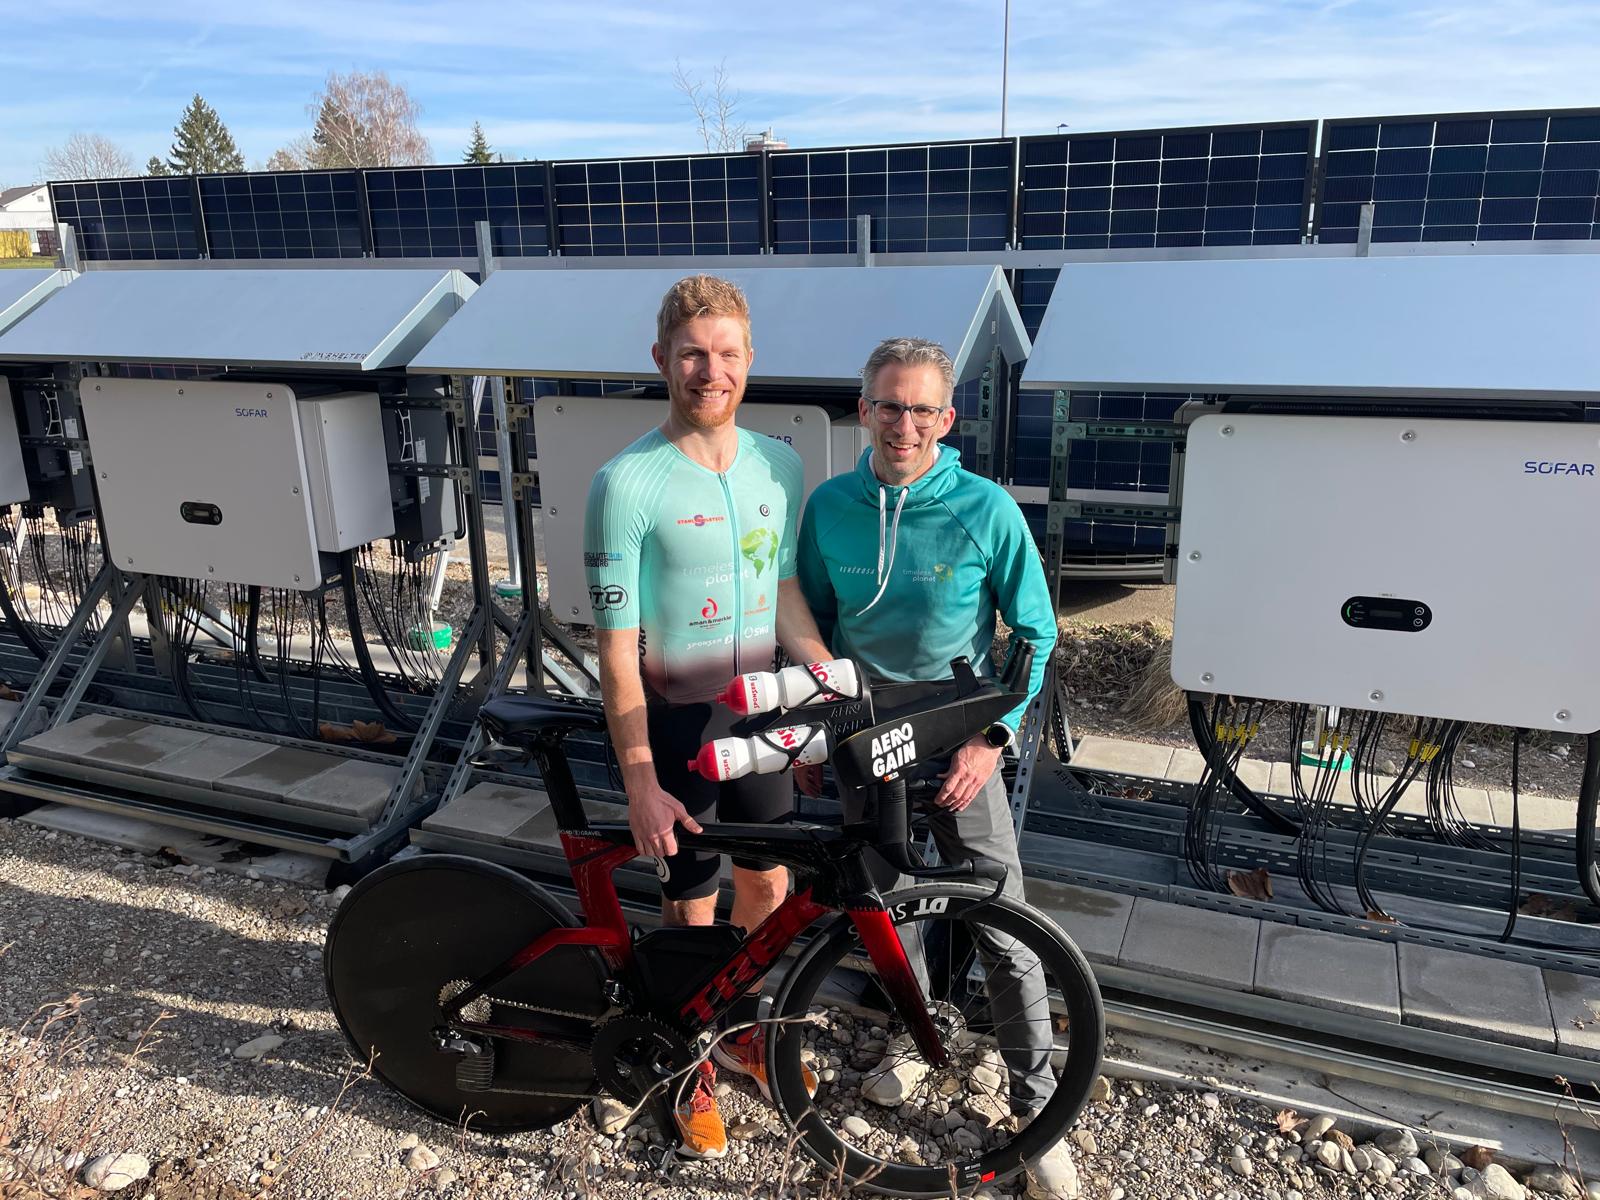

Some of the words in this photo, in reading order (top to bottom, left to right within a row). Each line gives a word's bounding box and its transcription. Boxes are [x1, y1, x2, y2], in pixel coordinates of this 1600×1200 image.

[235, 407, 268, 418] SOFAR
[1524, 461, 1595, 476] SOFAR
[871, 722, 914, 759] AERO
[872, 740, 917, 778] GAIN
[913, 897, 950, 916] DT
